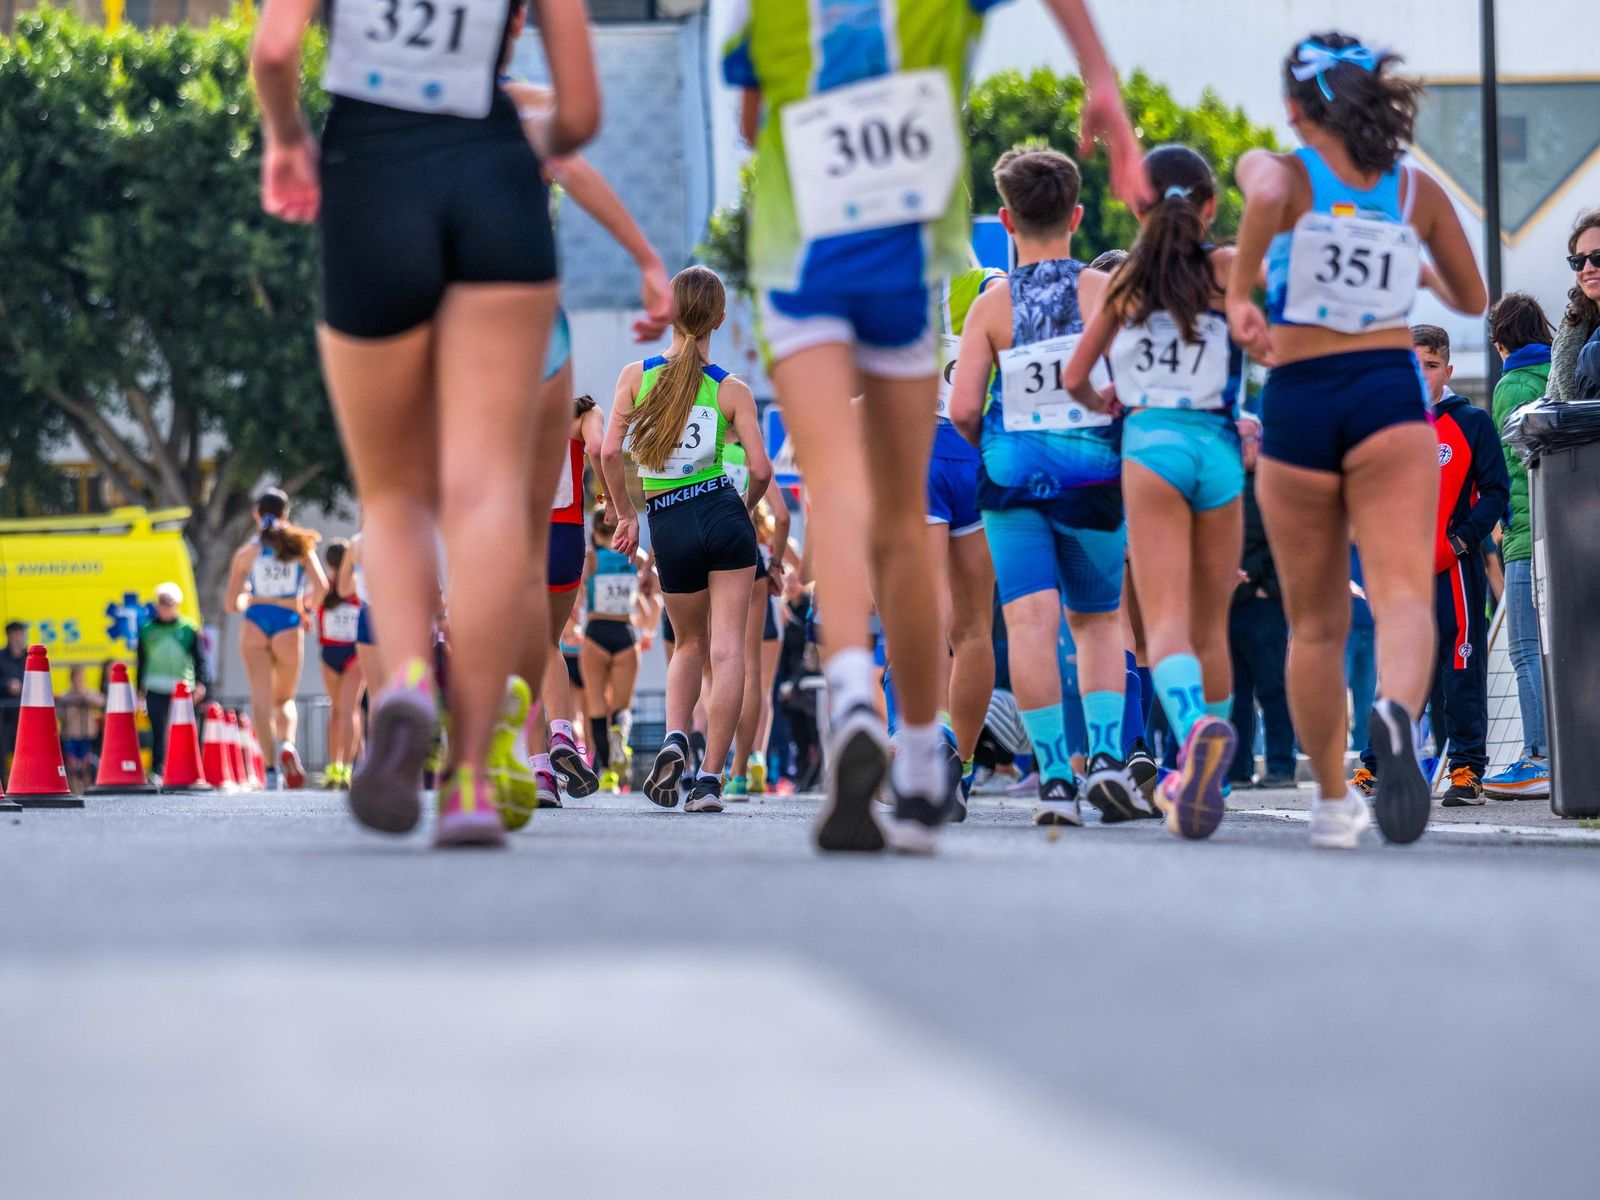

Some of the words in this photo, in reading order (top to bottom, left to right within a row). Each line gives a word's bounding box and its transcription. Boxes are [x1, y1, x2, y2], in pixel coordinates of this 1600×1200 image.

[365, 0, 467, 53] 321
[826, 109, 931, 178] 306
[1315, 244, 1392, 291] 351
[1024, 359, 1063, 394] 31
[1136, 337, 1207, 375] 347
